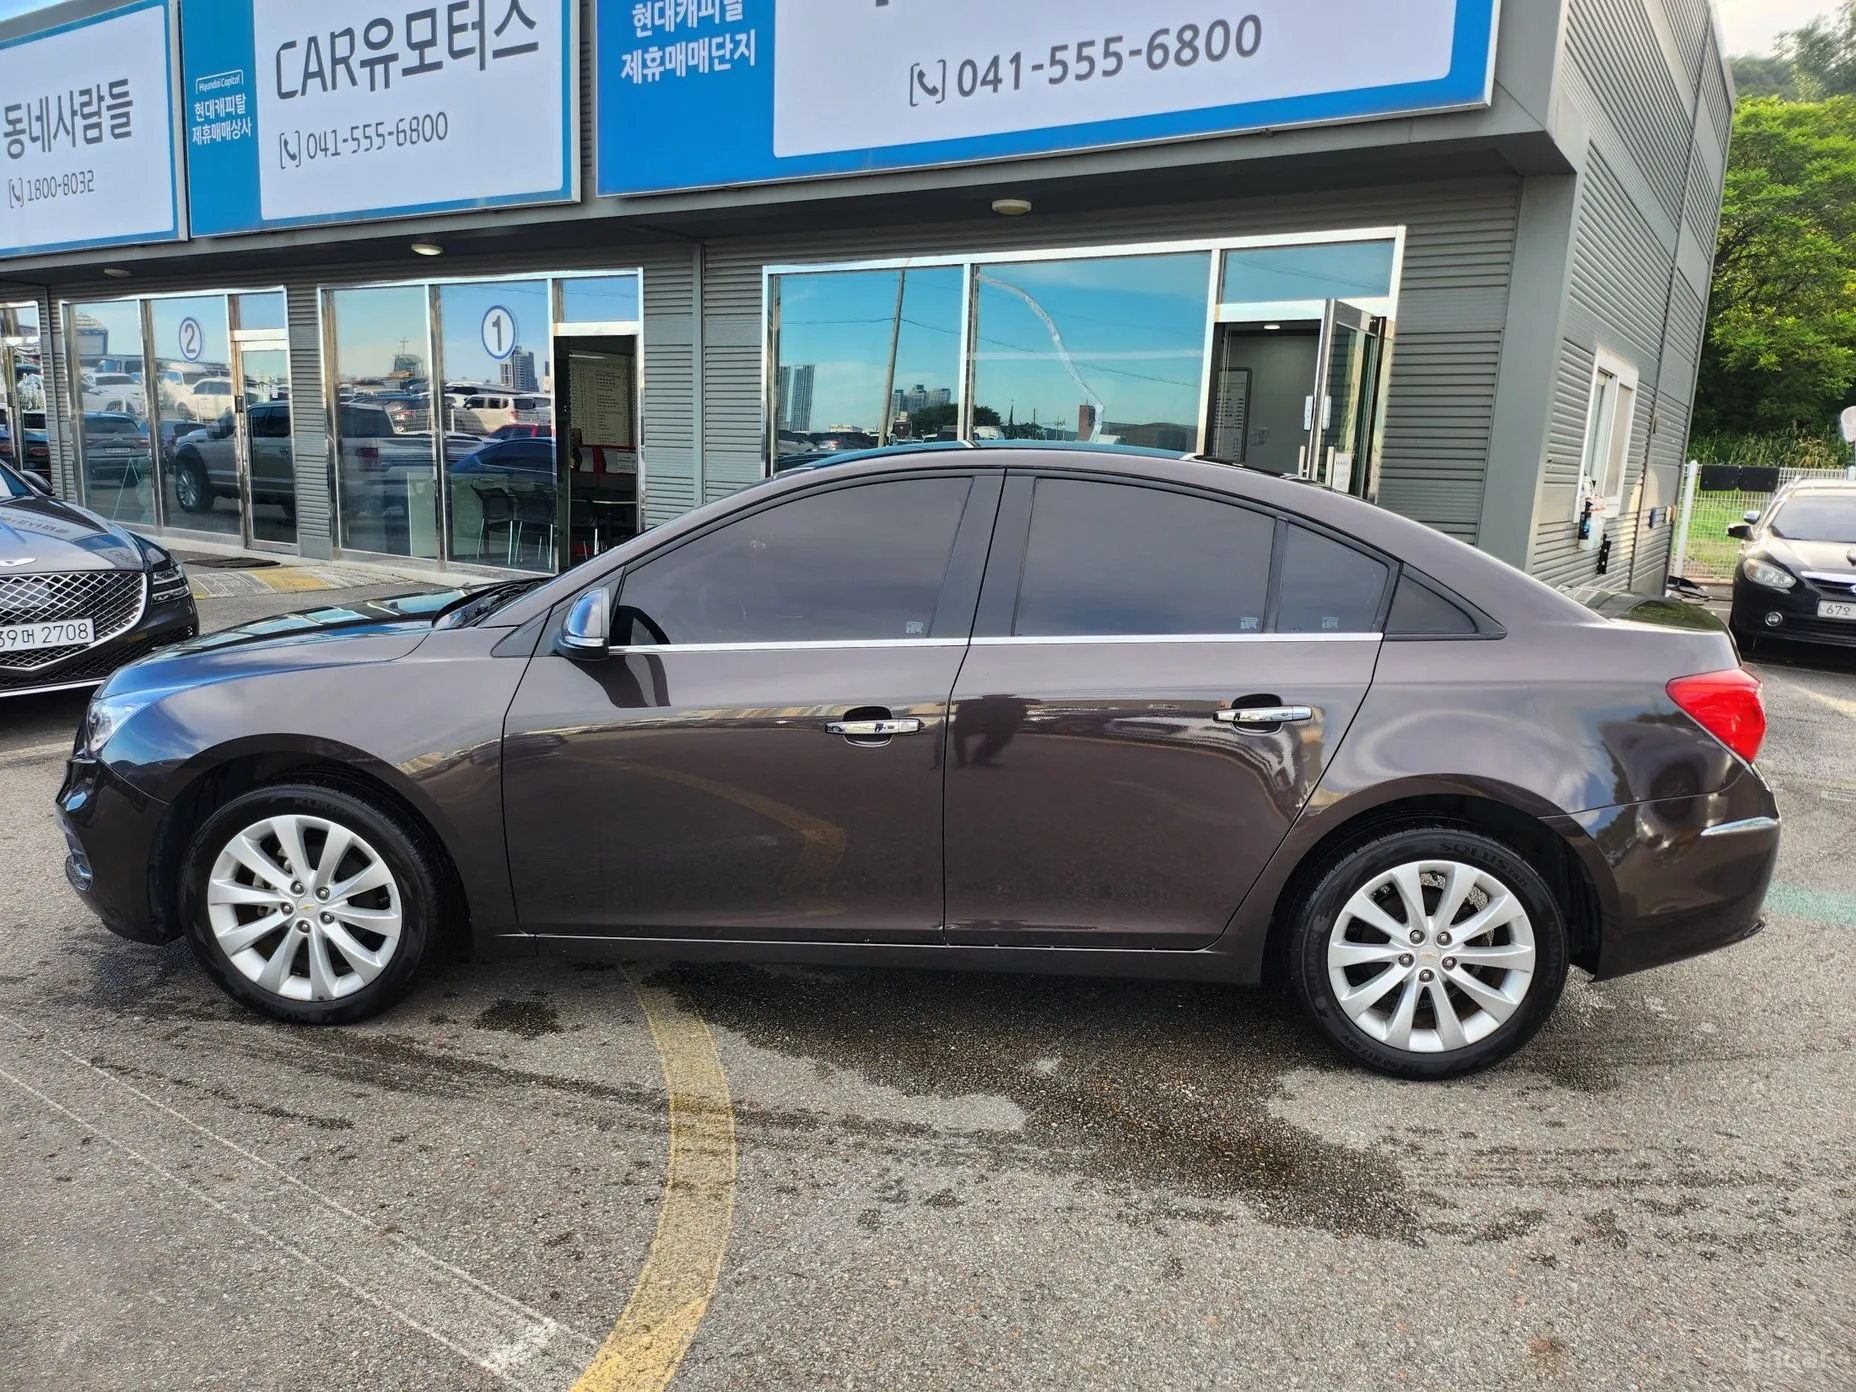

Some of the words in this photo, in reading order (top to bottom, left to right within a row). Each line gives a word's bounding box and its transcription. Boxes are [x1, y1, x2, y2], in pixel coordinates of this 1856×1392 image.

[276, 0, 539, 100] CAR유모터스
[620, 29, 756, 84] 제휴매매단지
[957, 13, 1262, 98] 041-555-6800
[3, 78, 134, 160] 동네사람들
[194, 93, 246, 122] 현대캐피탈
[192, 117, 252, 145] 제휴매매상사
[306, 111, 448, 159] 041-555-6800
[26, 169, 95, 202] 1800-8032
[184, 323, 197, 353] 2
[492, 315, 502, 351] 1
[1826, 604, 1851, 616] 67오
[41, 623, 89, 643] 2708
[1439, 842, 1508, 870] SOLUS
